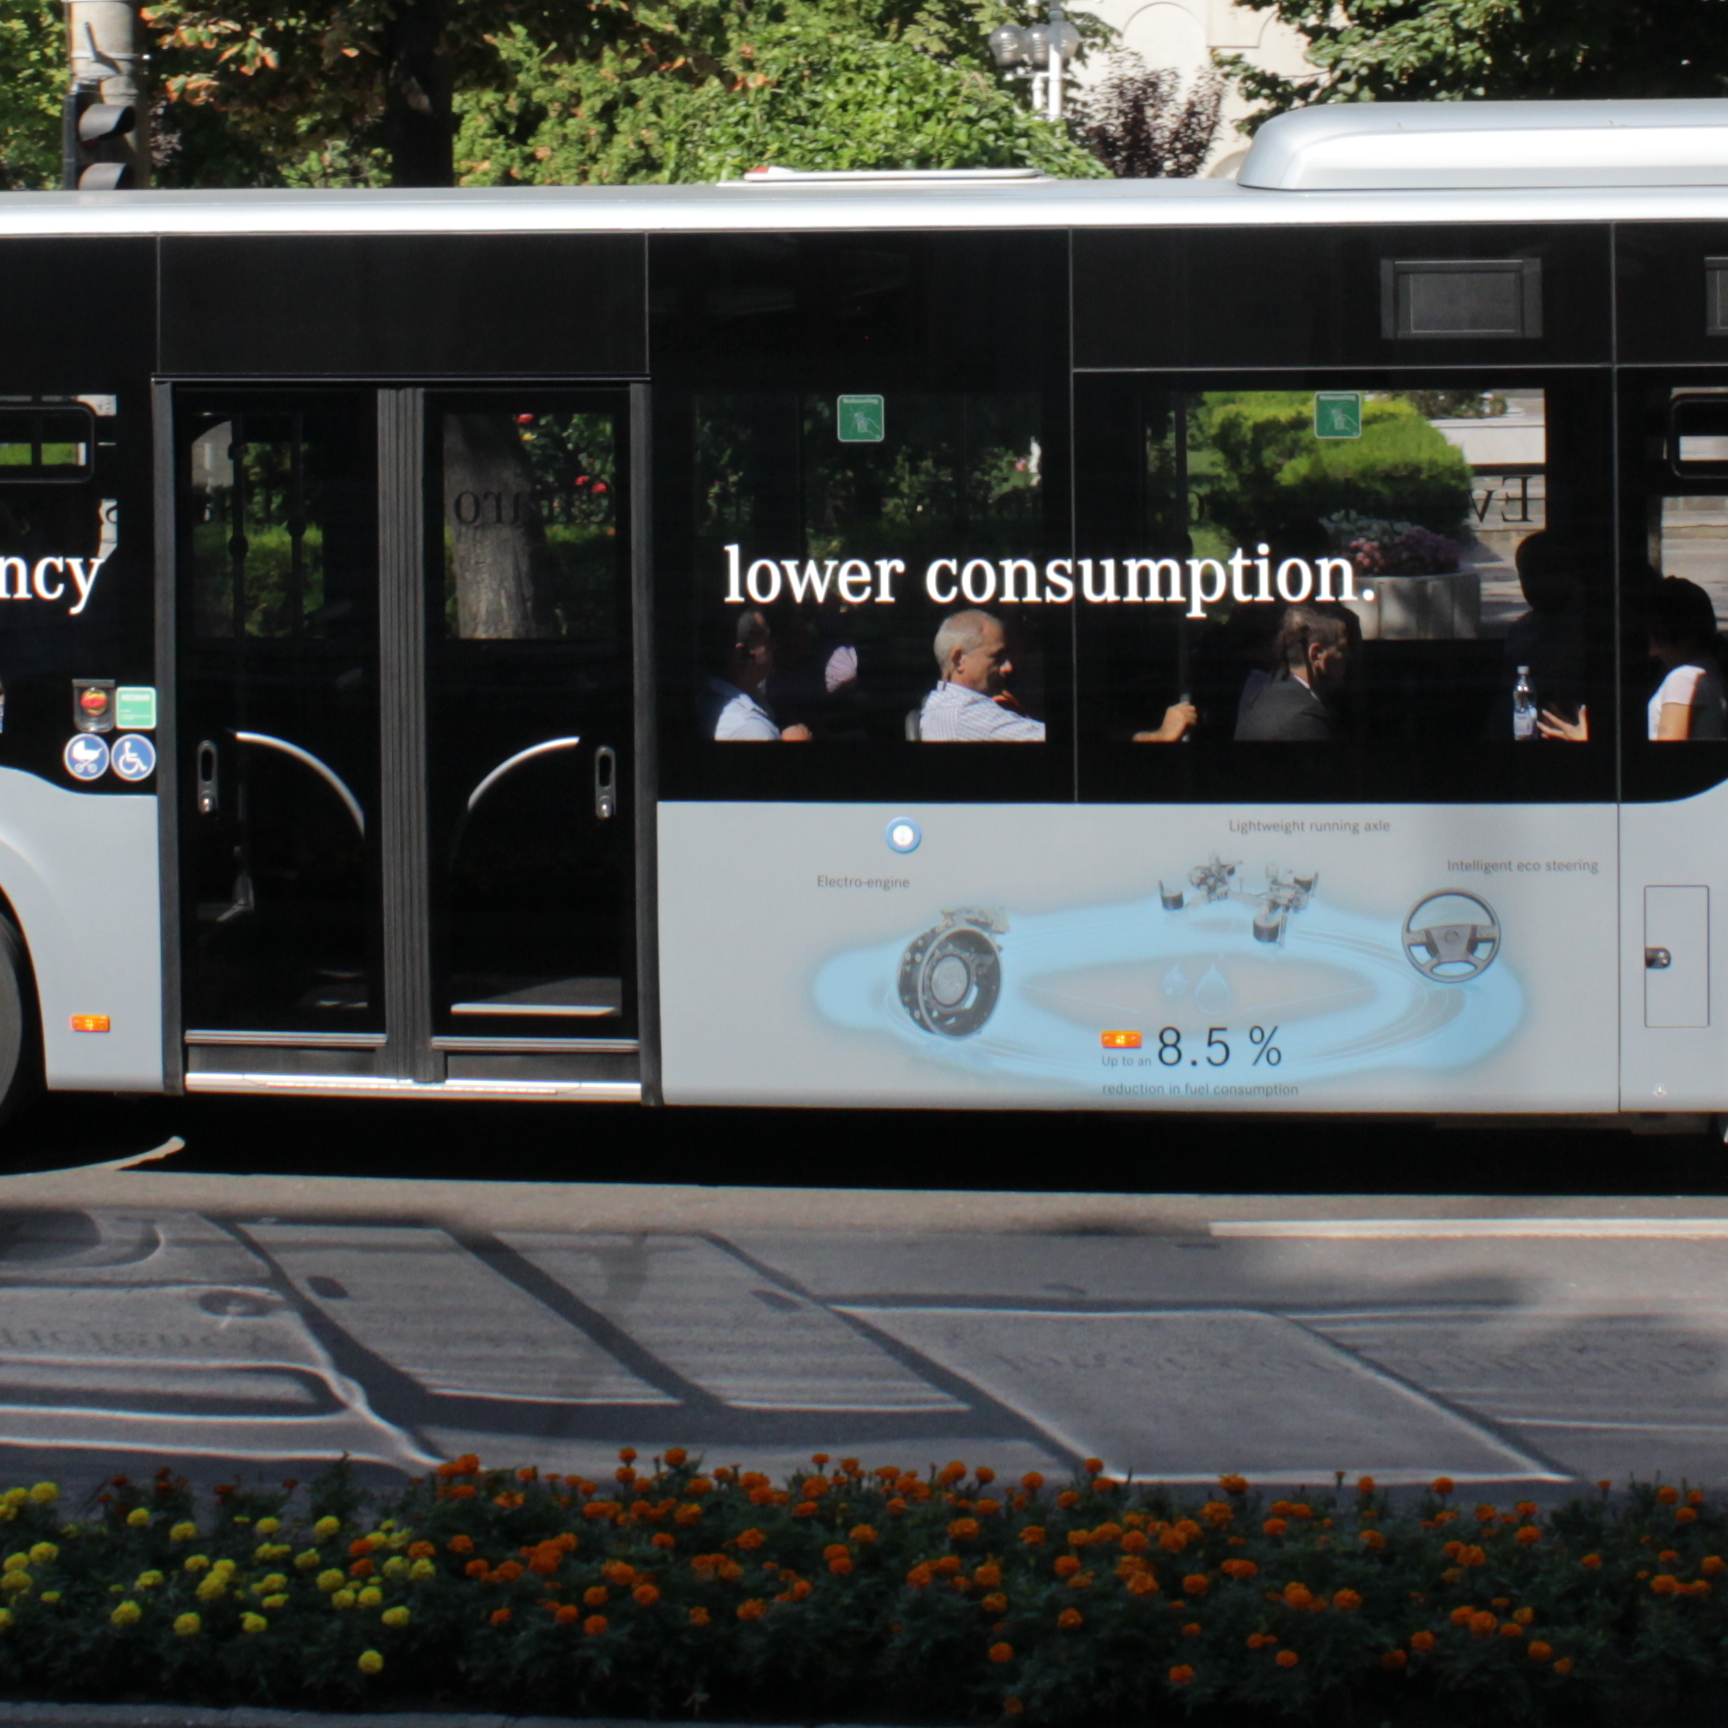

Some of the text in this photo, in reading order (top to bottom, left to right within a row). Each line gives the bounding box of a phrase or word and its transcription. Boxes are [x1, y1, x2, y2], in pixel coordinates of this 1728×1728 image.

[723, 543, 1376, 618] lower consumption.
[1229, 819, 1391, 834] Lightweight running axle
[1447, 859, 1600, 874] Intelligent eco steering
[817, 875, 910, 890] Electro-engine
[1158, 1025, 1282, 1066] 8.5 %
[1101, 1055, 1152, 1068] Up to an
[1102, 1083, 1299, 1098] reduction in fuel consumption
